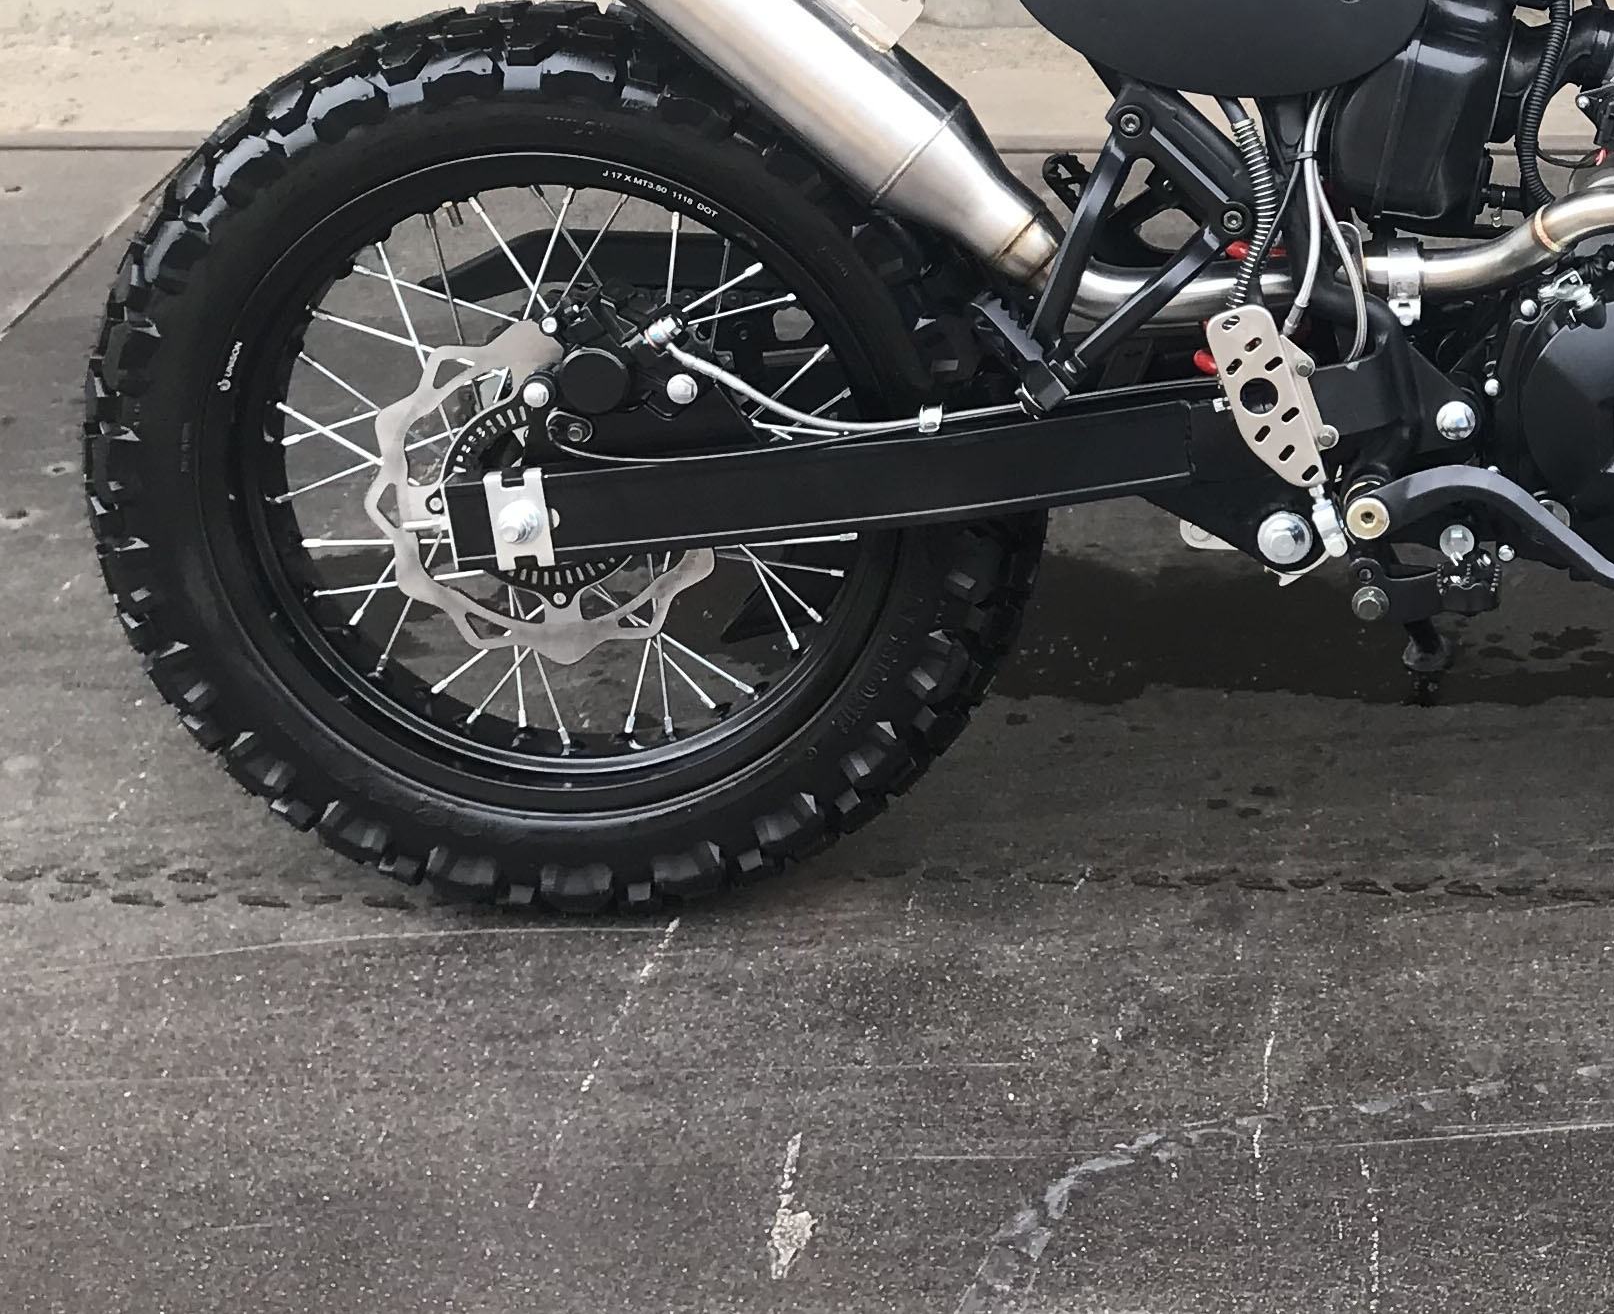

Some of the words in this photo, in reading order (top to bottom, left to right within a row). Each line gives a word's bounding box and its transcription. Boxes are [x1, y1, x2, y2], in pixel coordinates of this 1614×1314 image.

[611, 171, 623, 179] 17
[623, 174, 633, 183] X
[672, 191, 694, 206] 1118
[696, 202, 719, 218] DOT
